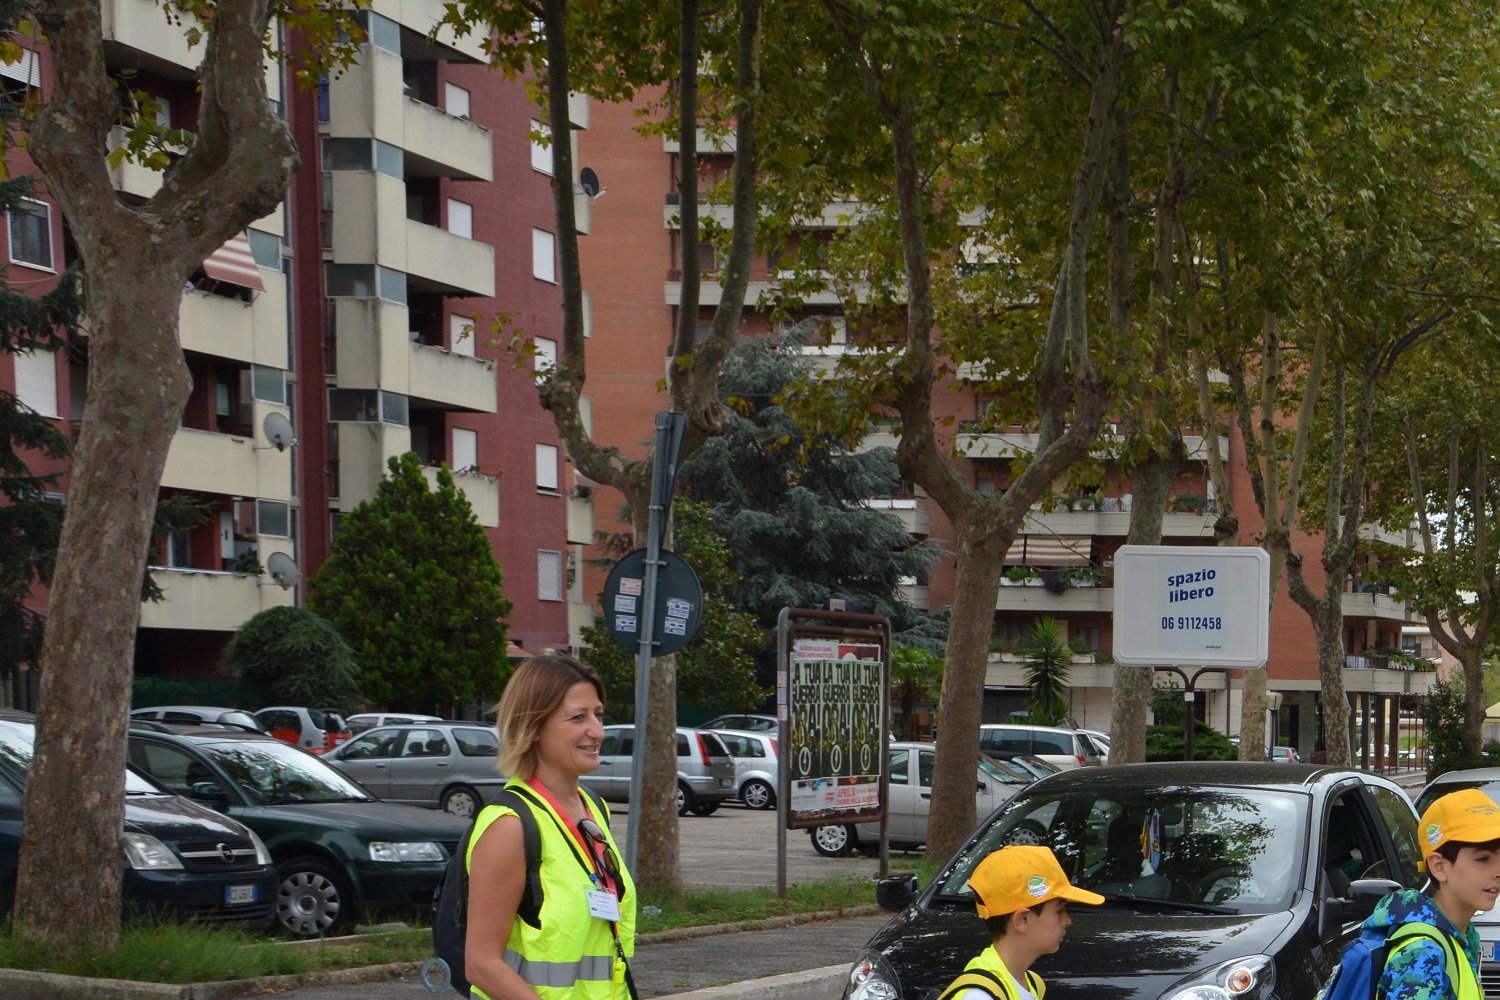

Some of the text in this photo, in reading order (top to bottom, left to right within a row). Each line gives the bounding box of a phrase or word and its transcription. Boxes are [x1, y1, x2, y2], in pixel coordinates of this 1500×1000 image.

[1167, 569, 1216, 587] spazio
[1169, 587, 1214, 603] libero
[1162, 617, 1222, 630] 06 9112458
[804, 663, 820, 684] TUA
[823, 663, 850, 685] LA TUA
[853, 663, 880, 685] LA TUA
[823, 684, 850, 704] GUERRA
[852, 685, 880, 704] GUERRA
